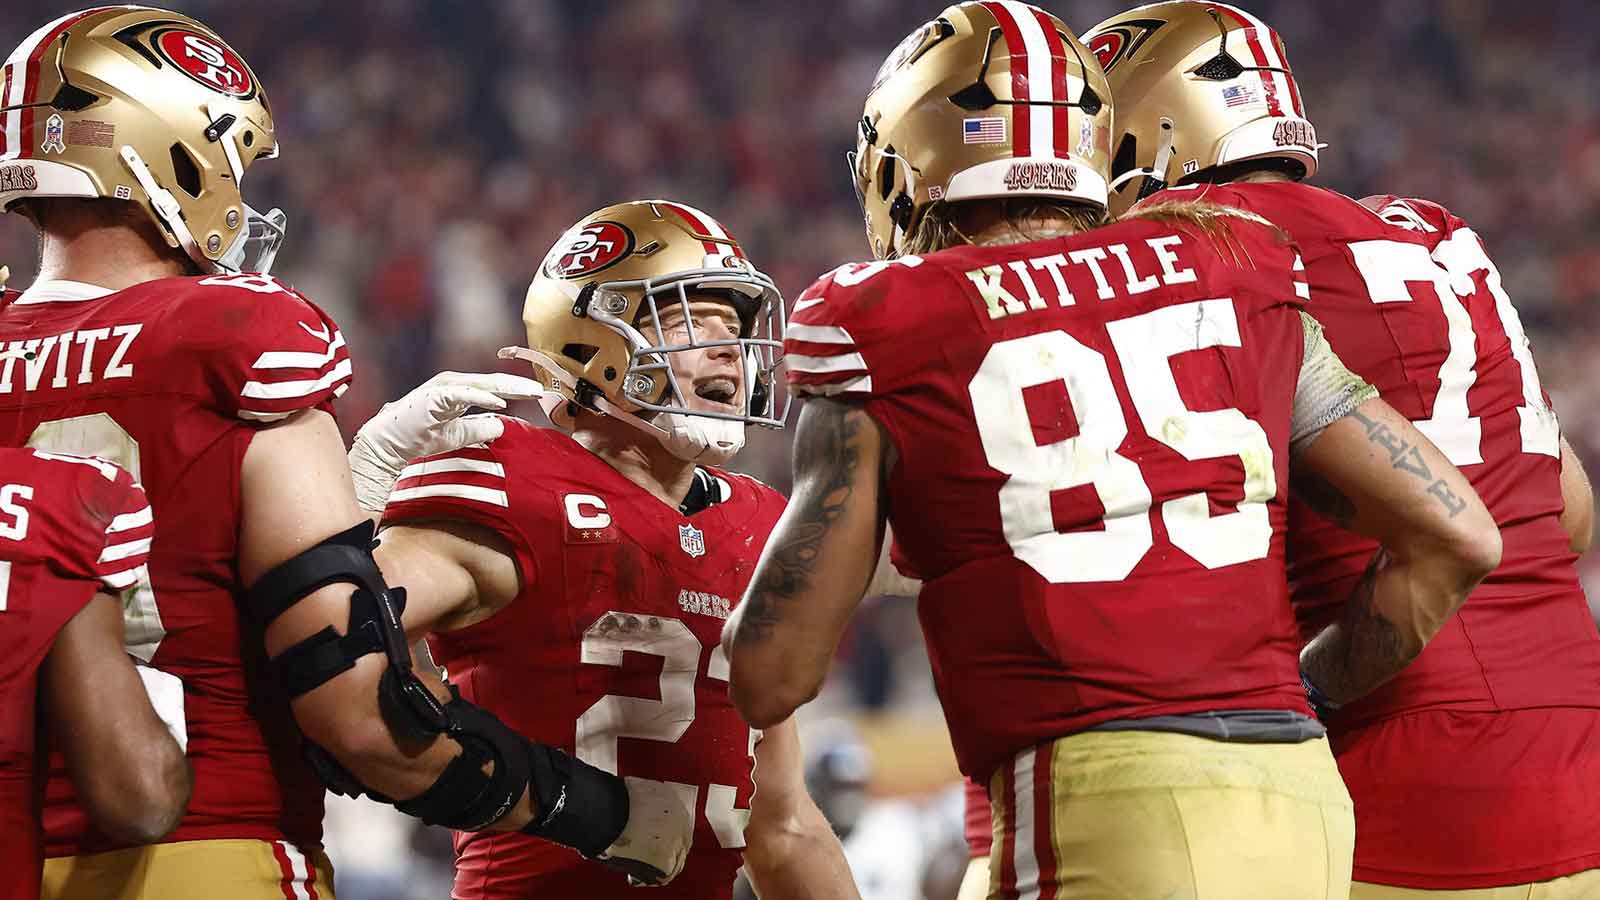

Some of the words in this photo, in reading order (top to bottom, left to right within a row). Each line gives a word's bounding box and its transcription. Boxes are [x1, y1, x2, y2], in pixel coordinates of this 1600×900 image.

[1004, 163, 1078, 192] 49ERS
[1183, 161, 1197, 173] 77
[117, 187, 129, 198] 68
[965, 235, 1198, 320] KITTLE
[0, 323, 144, 394] IVITZ
[1347, 227, 1562, 467] 77
[967, 297, 1277, 584] 85
[563, 493, 612, 529] C
[683, 537, 702, 552] NFL
